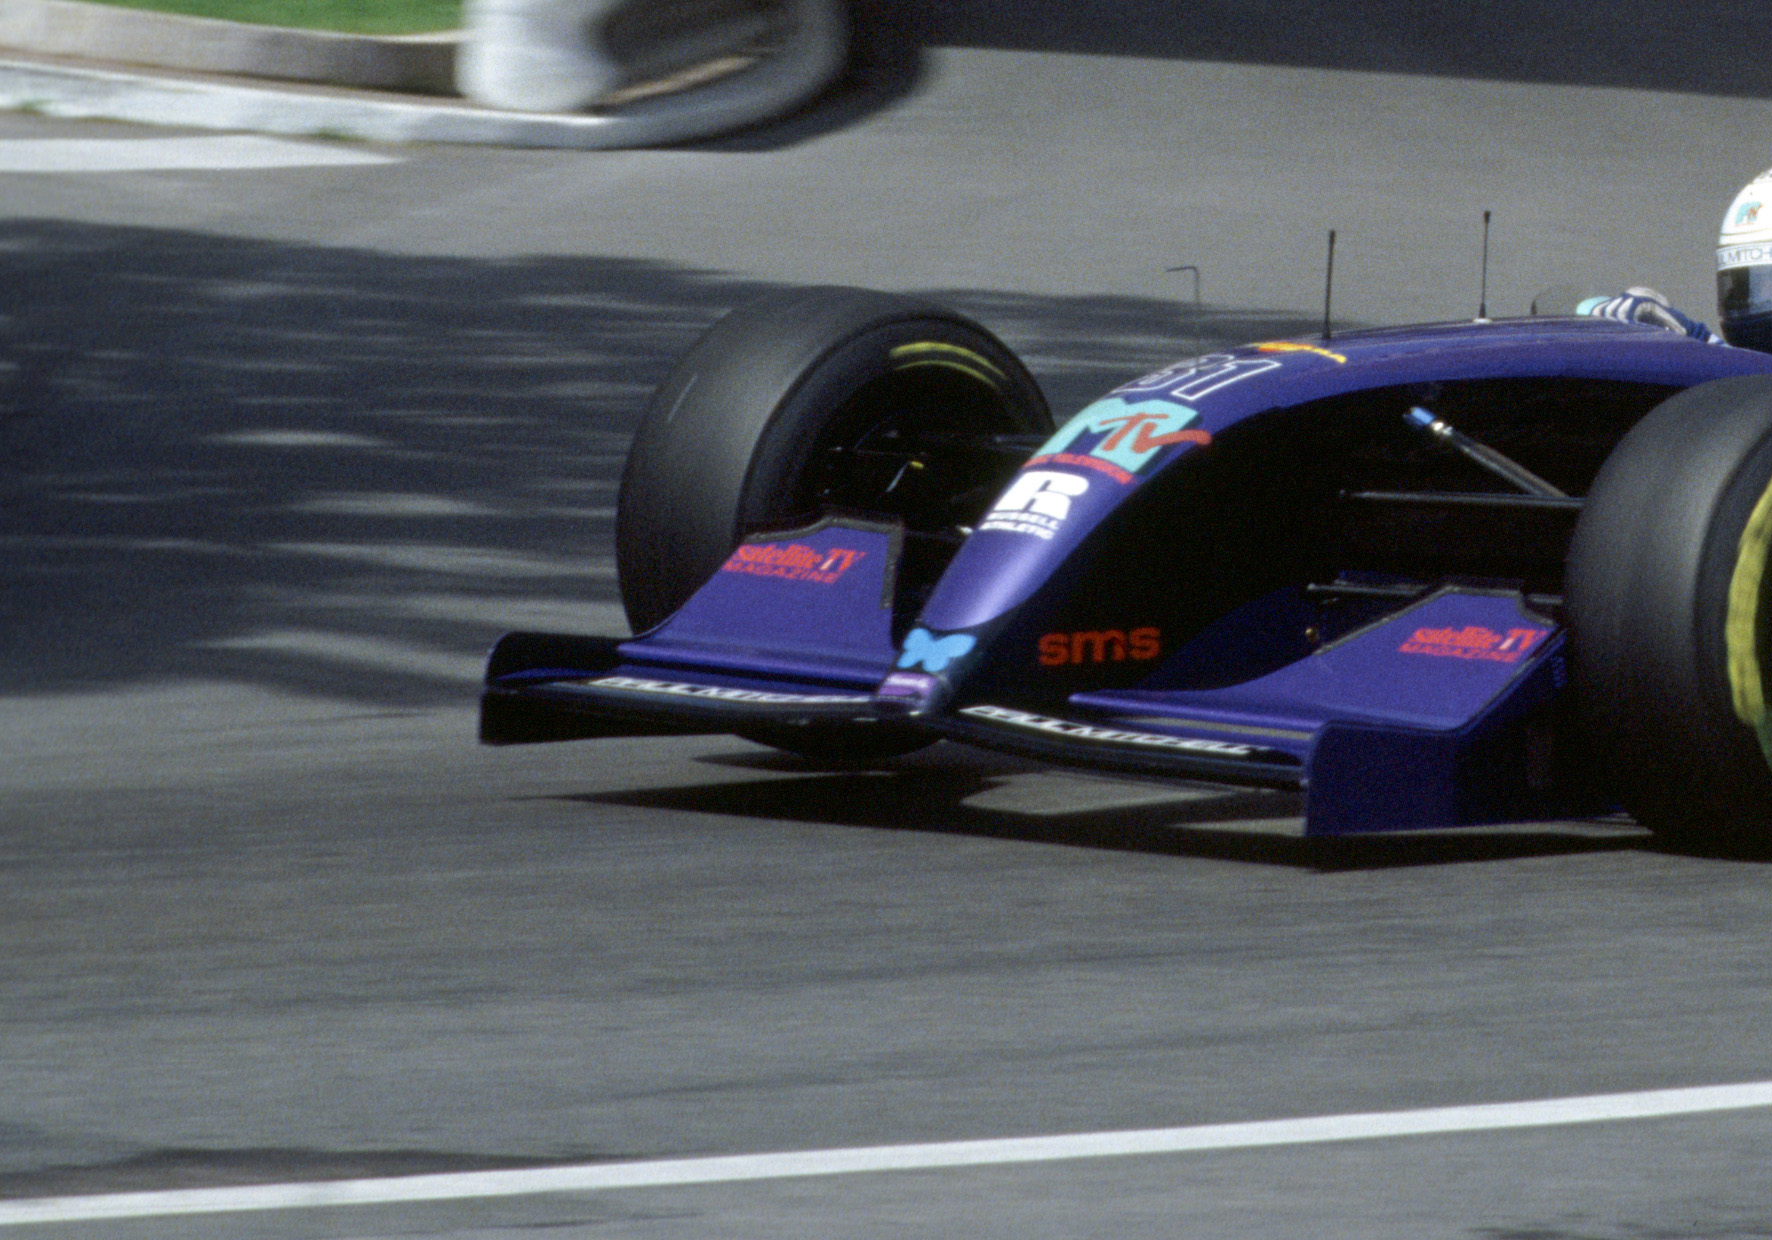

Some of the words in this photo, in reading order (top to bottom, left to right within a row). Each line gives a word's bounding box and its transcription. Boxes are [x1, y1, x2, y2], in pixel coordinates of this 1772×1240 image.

[1026, 397, 1213, 475] MTV
[993, 470, 1090, 521] R
[721, 559, 842, 584] MAGAZINE
[1037, 626, 1161, 666] sms
